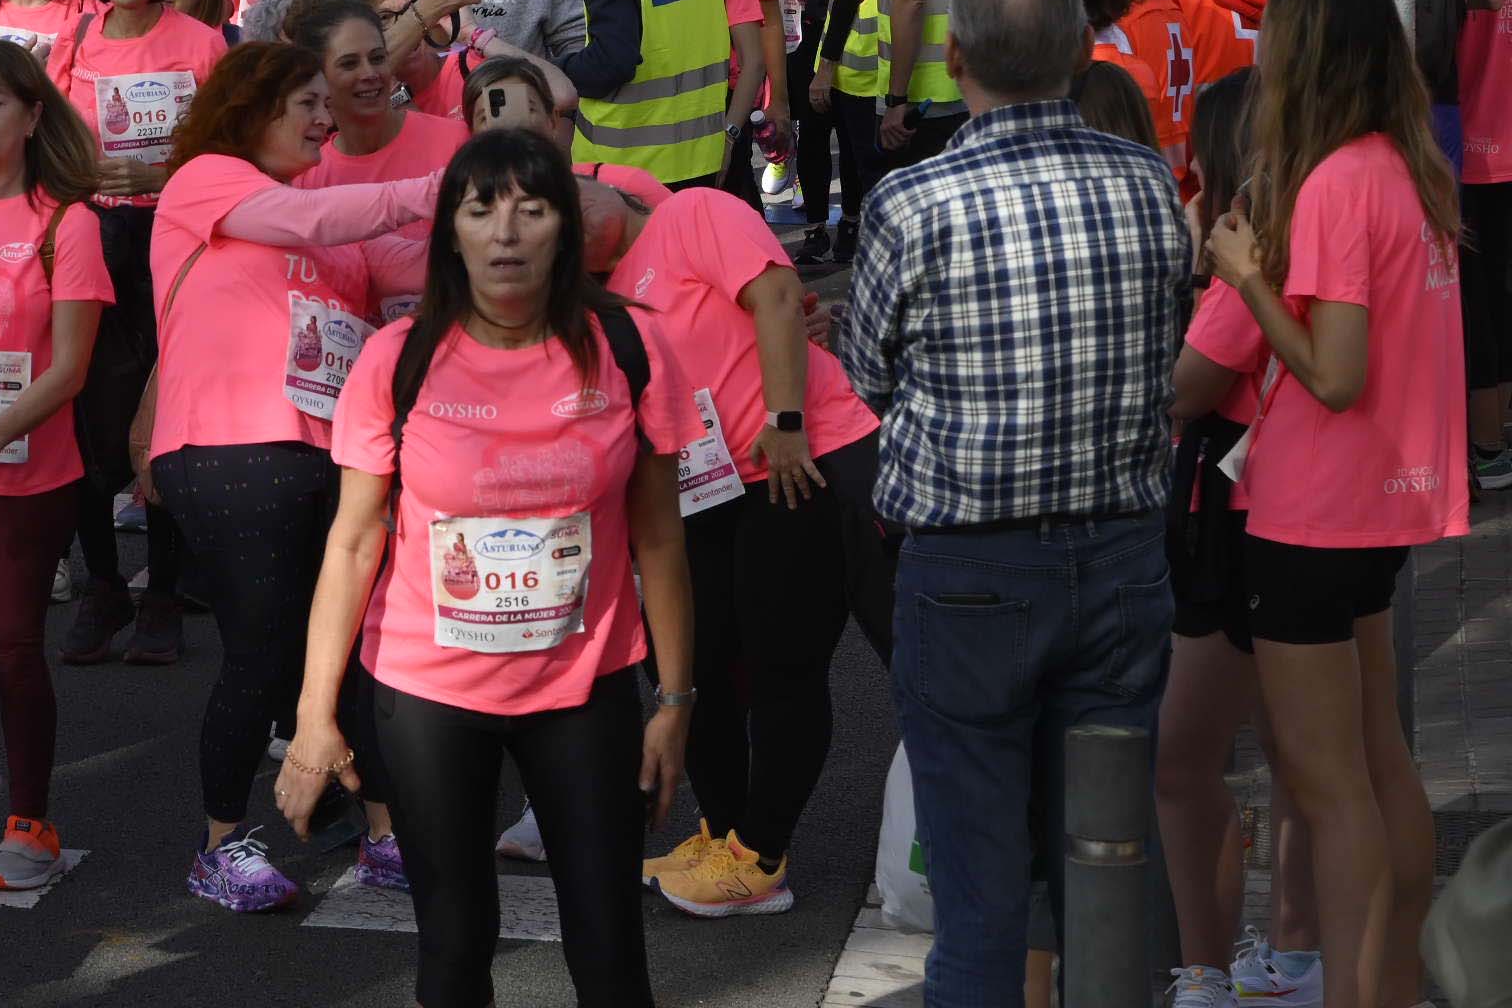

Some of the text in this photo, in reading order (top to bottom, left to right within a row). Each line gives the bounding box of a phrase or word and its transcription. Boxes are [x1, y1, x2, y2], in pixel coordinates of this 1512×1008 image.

[128, 89, 169, 98] ASTURIANA
[132, 108, 168, 124] 016
[137, 126, 165, 137] 22377
[113, 141, 140, 150] CARRERA
[284, 253, 318, 283] TU
[324, 351, 354, 374] 016
[295, 379, 326, 393] CARRERA
[291, 394, 325, 410] OYSHO
[429, 401, 497, 420] OYSHO
[678, 466, 691, 477] 09
[688, 474, 710, 488] MUJER
[1383, 473, 1440, 495] OYSHO
[699, 482, 734, 501] Santander
[480, 542, 541, 553] ASTURIANA
[484, 570, 539, 591] 016
[495, 595, 530, 608] 2516
[451, 609, 556, 623] CARRERA DE LA MUJER
[449, 626, 496, 643] OYSHO
